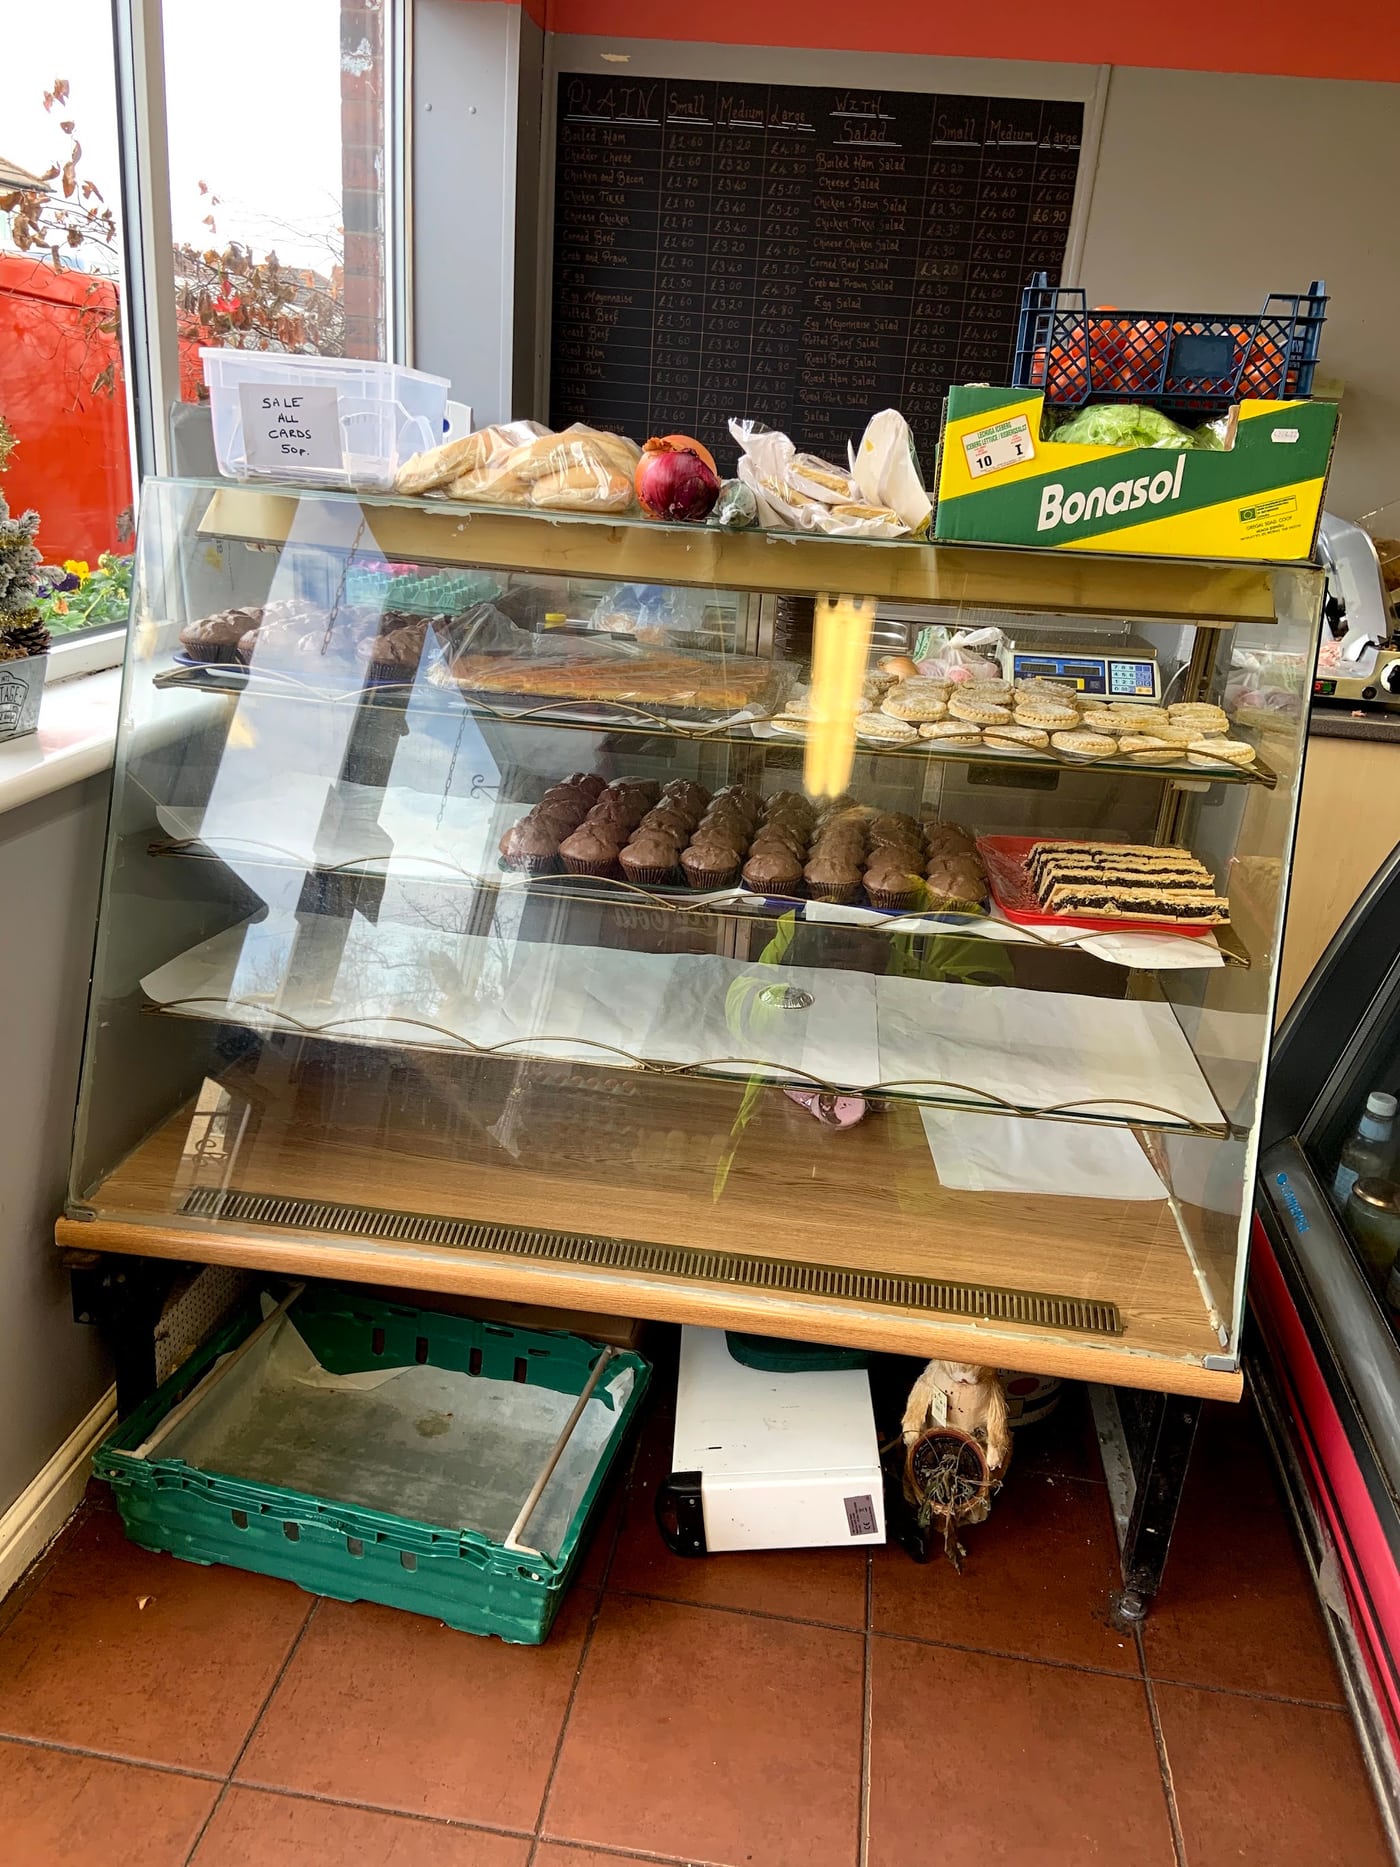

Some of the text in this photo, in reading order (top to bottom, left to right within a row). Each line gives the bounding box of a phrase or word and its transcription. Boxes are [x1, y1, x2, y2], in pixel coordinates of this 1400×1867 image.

[567, 79, 659, 118] PLAIN
[667, 92, 705, 116] Small
[835, 91, 882, 112] WITH
[720, 96, 765, 125] Medium
[771, 103, 806, 128] Large
[840, 119, 887, 142] Salad
[935, 114, 976, 142] Small
[989, 120, 1034, 146] Medium
[1043, 124, 1078, 150] Large
[816, 152, 905, 171] Boiled Ham Salad
[616, 170, 644, 186] Bacon
[819, 177, 880, 191] Cheese Salad
[883, 198, 908, 213] Salad
[594, 231, 616, 246] Beef
[602, 250, 628, 264] Prawn
[841, 257, 860, 273] Beef
[864, 259, 889, 271] Salad
[871, 279, 894, 291] Salad
[814, 295, 862, 311] Egg Salad
[594, 308, 619, 325] Beef
[804, 317, 820, 331] Egg
[873, 318, 898, 331] Salad
[831, 334, 854, 349] Beef
[856, 336, 880, 349] Salad
[828, 353, 852, 368] Beef
[854, 354, 878, 368] Salad
[830, 373, 848, 387] Ham
[852, 373, 877, 387] Salad
[262, 397, 303, 409] SALE
[847, 392, 869, 405] Salad
[278, 412, 298, 423] ALL
[804, 410, 830, 422] Salad
[268, 428, 312, 440] CARDS
[976, 455, 993, 469] 10
[1036, 453, 1187, 533] Bonasol
